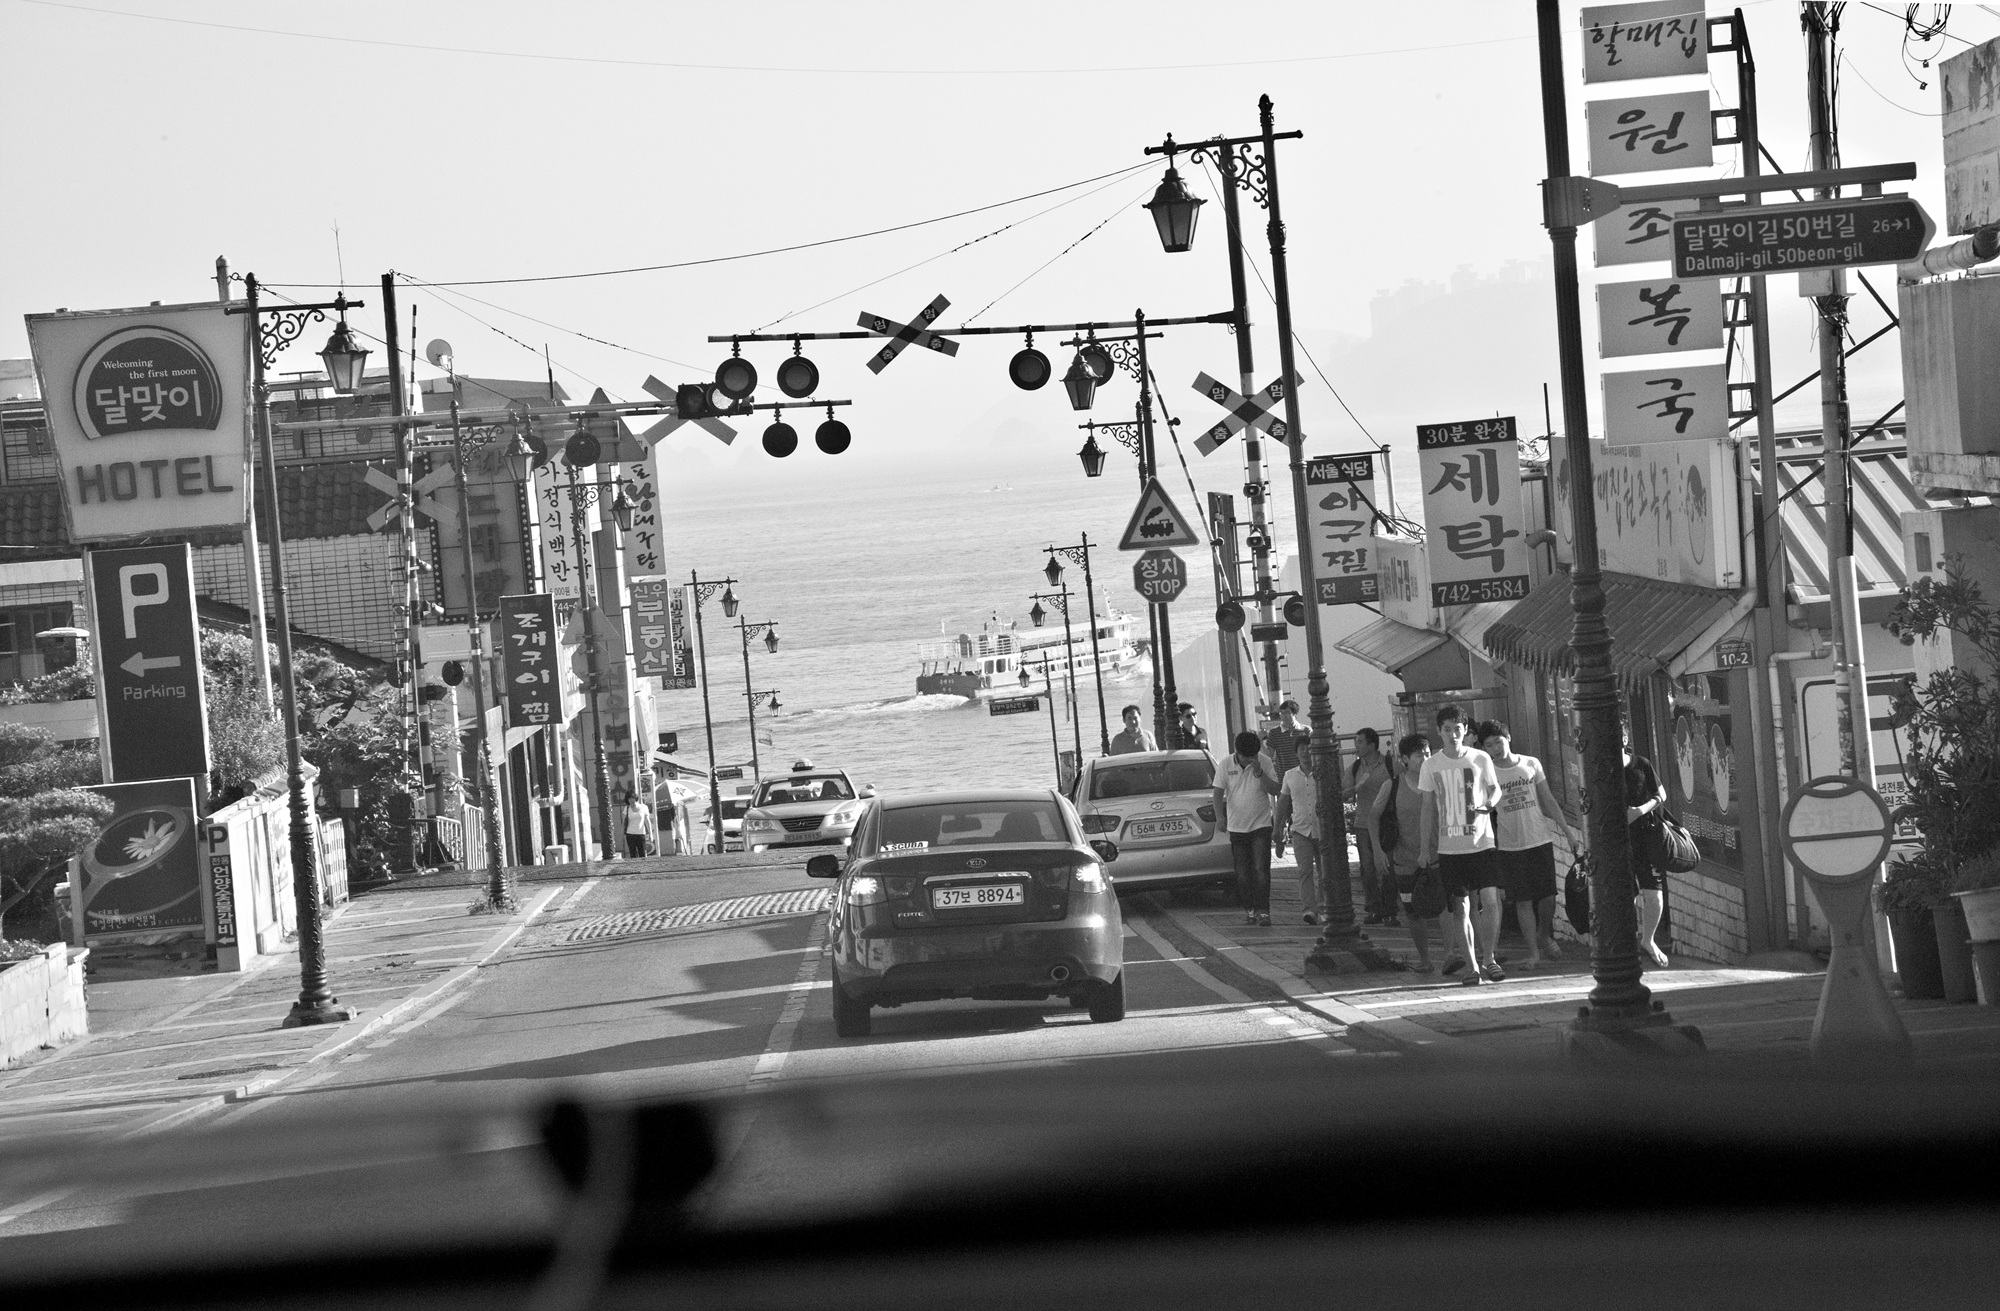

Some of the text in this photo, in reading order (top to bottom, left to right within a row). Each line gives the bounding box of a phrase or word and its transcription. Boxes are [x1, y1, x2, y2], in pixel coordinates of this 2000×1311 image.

[1589, 18, 1697, 66] 할매집
[1686, 242, 1864, 272] Dalmaji-gil 50beon-gil
[103, 358, 154, 370] Welcoming
[129, 367, 197, 379] the first moon
[95, 380, 202, 425] 달맞이
[1426, 419, 1509, 444] 30분 완성
[76, 455, 234, 504] HOTEL
[1341, 461, 1368, 477] 식당
[540, 461, 570, 582] 가정식백반
[1428, 448, 1519, 573] 세탁
[1319, 487, 1368, 574] 아구찜
[1140, 558, 1178, 578] 정지
[1143, 577, 1181, 595] STOP
[1437, 577, 1525, 603] 742-5584
[119, 562, 169, 639] P
[637, 600, 670, 673] 부동산
[1721, 652, 1749, 665] 10-2
[123, 683, 186, 700] Parking
[207, 826, 228, 853] P
[1160, 821, 1183, 832] 4935
[942, 888, 1014, 905] 37보 8894
